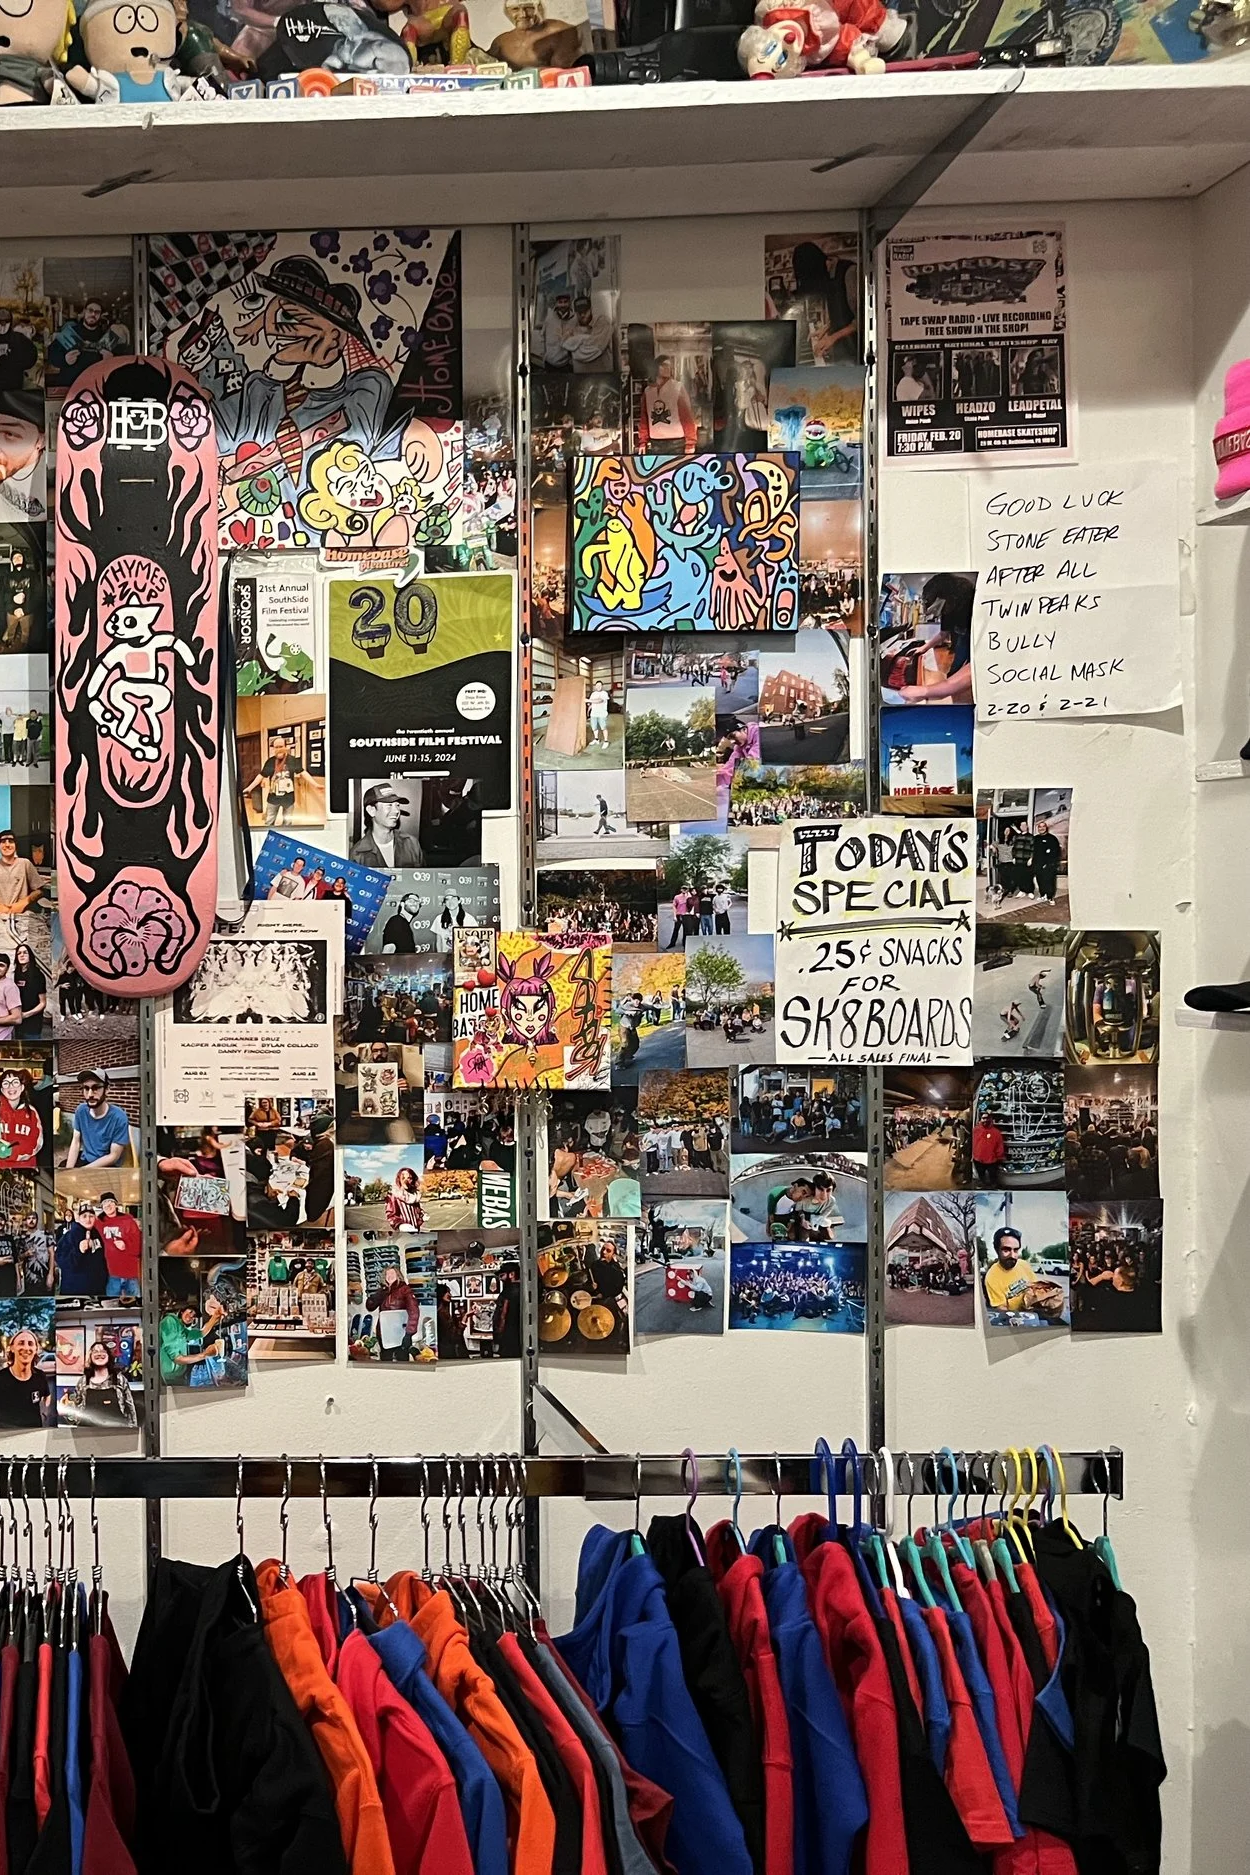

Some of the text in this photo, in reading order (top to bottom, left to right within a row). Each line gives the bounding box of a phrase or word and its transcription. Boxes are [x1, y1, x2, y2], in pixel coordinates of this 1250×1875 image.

[900, 311, 1051, 326] TAPE SWAP RADIO LIVE RECORDING
[925, 326, 944, 336] FREE
[946, 325, 972, 335] SHOW
[974, 325, 983, 334] IN
[984, 324, 1000, 334] THE
[901, 404, 936, 417] WIPES
[955, 401, 996, 414] HEADZO
[1008, 399, 1063, 413] LEADPETAL
[930, 430, 948, 442] FEB.
[949, 430, 961, 440] 20
[977, 427, 1058, 439] HOMEBASE SKATESHOP
[897, 442, 934, 453] 7:30 P.M.
[986, 490, 1125, 517] GOOD LUCK
[987, 525, 1120, 552] STONE EATER
[100, 559, 167, 593] THYMES
[986, 559, 1097, 587] AFTER ALL
[258, 583, 309, 593] 21st Annual
[268, 595, 309, 604] SouthSide
[981, 594, 1102, 619] TWIN PEAKS
[240, 584, 252, 645] SPONSOR
[261, 606, 309, 615] Film Festival
[348, 582, 438, 641] 20
[988, 631, 1056, 653] BULLY
[987, 658, 1125, 685] SOCIAL MASK
[987, 702, 1031, 716] 2-20
[1059, 696, 1108, 711] 2-21
[349, 735, 503, 748] SOUTHSIDE FILM FESTIVAL
[383, 753, 457, 764] JUNE 11-15, 2024
[792, 823, 969, 878] TODAY'S
[792, 878, 973, 915] SPECIAL
[457, 930, 494, 940] USOPP
[879, 936, 963, 967] SNACKS
[838, 974, 901, 996] FOR
[460, 989, 499, 1015] HOME
[780, 995, 973, 1052] SK8BOARDS
[828, 1053, 932, 1064] ALL SALES FINAL
